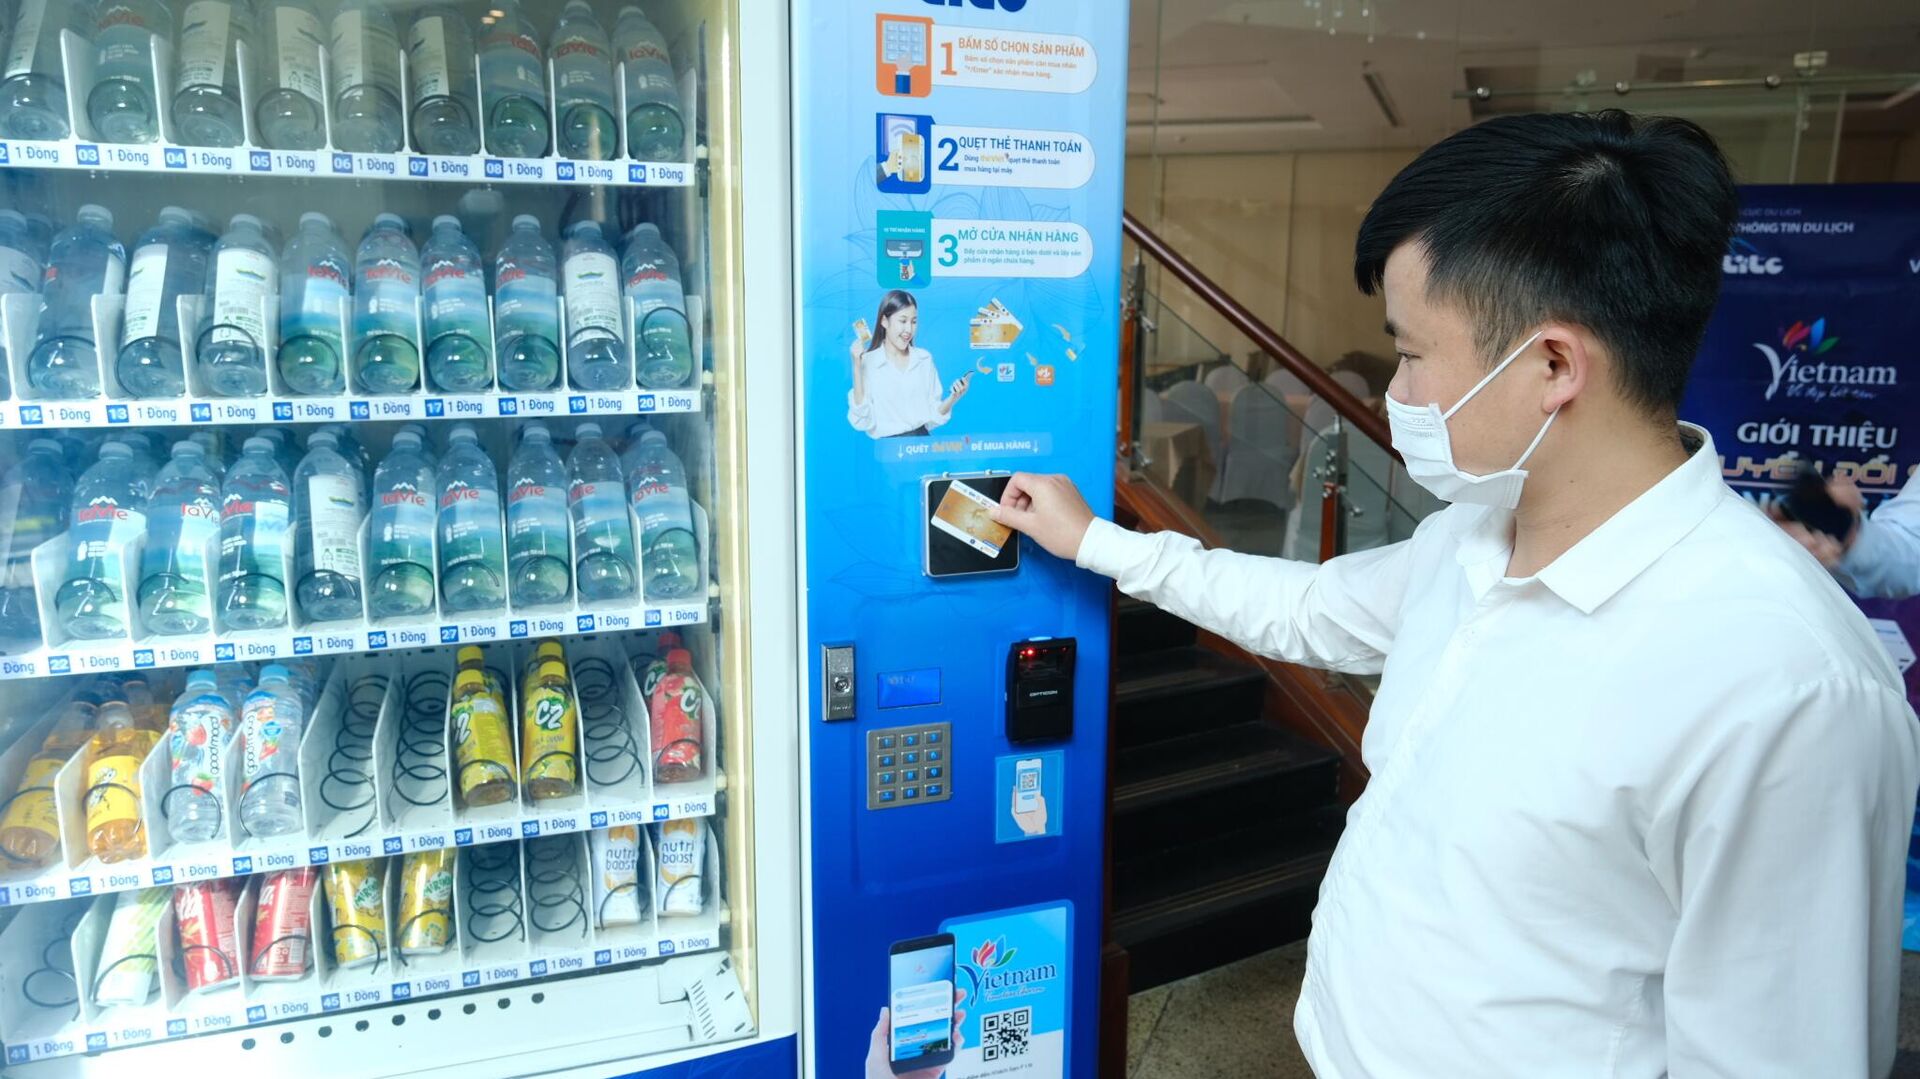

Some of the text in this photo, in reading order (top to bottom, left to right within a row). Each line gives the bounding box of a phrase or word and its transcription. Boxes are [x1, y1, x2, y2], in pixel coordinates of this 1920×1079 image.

[941, 42, 957, 76] 1
[959, 36, 982, 49] BẤM
[1001, 41, 1029, 53] CHỌN
[1033, 41, 1052, 54] SẢN
[1055, 44, 1084, 57] PHẨM
[78, 149, 97, 161] 03
[118, 149, 149, 165] Đồng
[167, 152, 185, 164] 04
[202, 152, 232, 169] Đồng
[938, 136, 1082, 171] 2 QUẸT THẺ THANH TOÁN
[334, 157, 350, 169] 06
[367, 159, 394, 173] Đồng
[410, 160, 425, 172] 07
[442, 161, 468, 176] Đồng
[487, 164, 502, 174] 08
[517, 164, 543, 178] Đồng
[631, 169, 645, 178] 10
[659, 168, 683, 181] Đồng
[1803, 222, 1822, 232] DU
[938, 234, 958, 267] 3
[1009, 228, 1042, 244] NHẬN
[1045, 229, 1078, 242] HÀNG
[1752, 343, 1897, 400] Vietnam
[275, 405, 291, 416] 15
[307, 404, 333, 417] Đồng
[427, 403, 442, 413] 17
[457, 401, 482, 413] Đồng
[571, 399, 585, 409] 19
[598, 398, 622, 410] Đồng
[639, 398, 653, 408] 20
[668, 397, 691, 409] Đồng
[1736, 418, 1897, 452] GIỚI THIỆU
[579, 618, 593, 628] 29
[606, 614, 629, 628] Đồng
[370, 634, 386, 645] 26
[400, 631, 426, 644] Đồng
[442, 629, 457, 640] 27
[472, 625, 496, 638] Đồng
[535, 700, 564, 729] C2
[592, 814, 606, 825] 39
[619, 810, 641, 823] Đồng
[456, 831, 471, 842] 37
[488, 827, 512, 840] Đồng
[385, 839, 401, 851] 36
[419, 835, 444, 848] Đồng
[662, 841, 694, 852] nutri
[311, 850, 327, 860] 35
[345, 844, 371, 858] Đồng
[662, 853, 693, 864] boost
[596, 953, 610, 962] 49
[624, 947, 647, 960] Đồng
[464, 974, 479, 984] 47
[494, 968, 518, 980] Đồng
[957, 964, 1056, 1007] Vietnam
